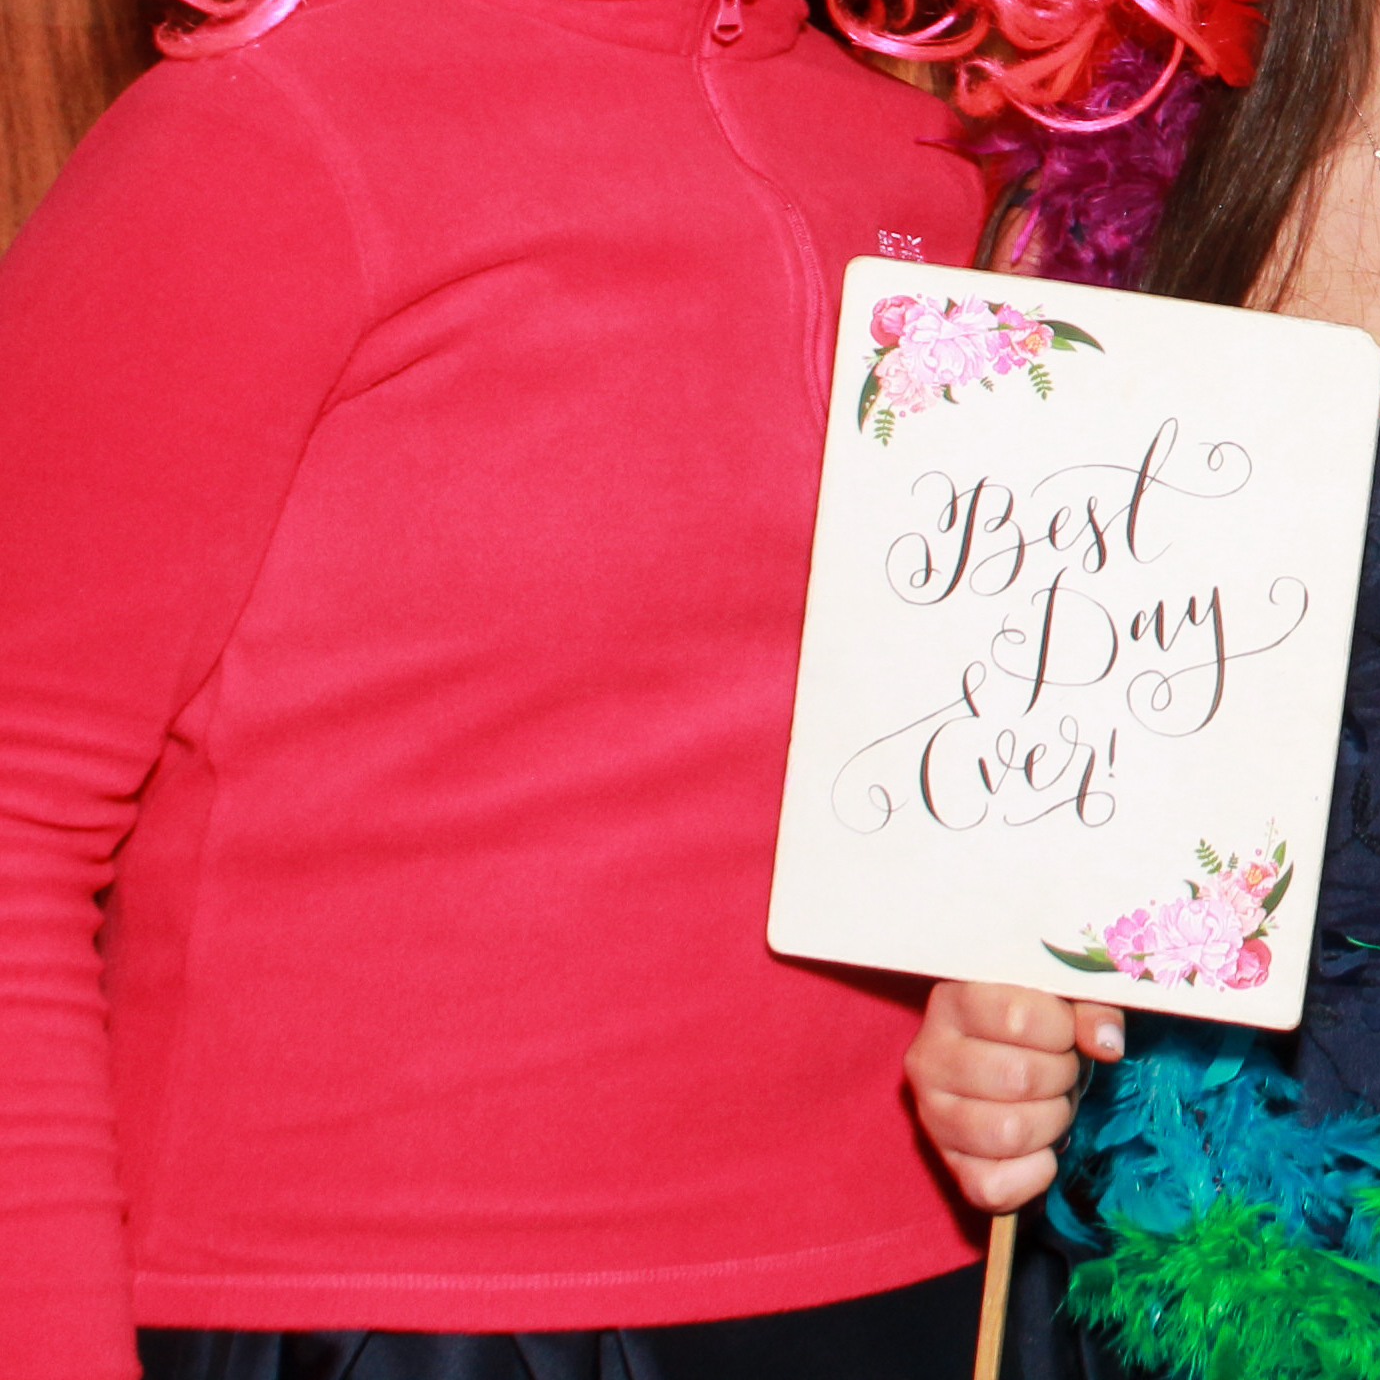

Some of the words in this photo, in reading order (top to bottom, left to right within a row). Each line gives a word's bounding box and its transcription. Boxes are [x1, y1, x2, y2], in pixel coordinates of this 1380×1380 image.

[885, 417, 1252, 606] Best
[990, 568, 1309, 737] Day
[831, 660, 1118, 834] Ever!
